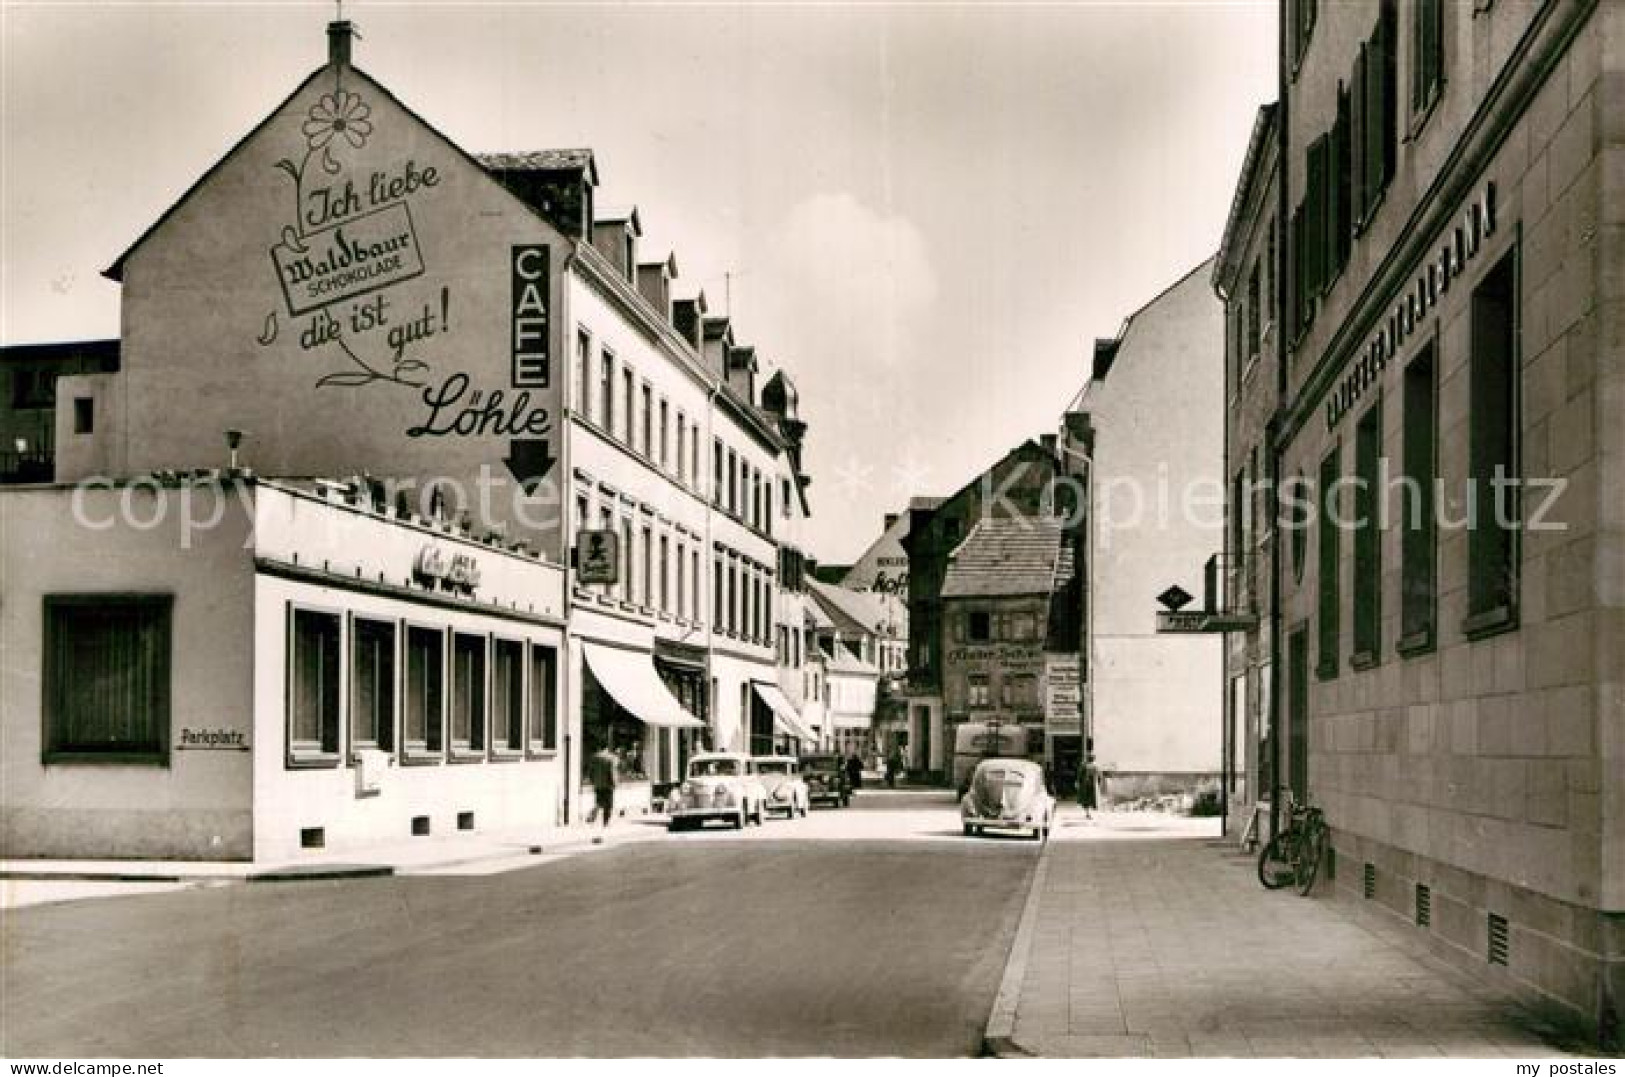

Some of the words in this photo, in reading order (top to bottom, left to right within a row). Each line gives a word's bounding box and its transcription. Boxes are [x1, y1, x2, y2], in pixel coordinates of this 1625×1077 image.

[307, 183, 362, 225] Ich
[367, 161, 440, 205] liebe
[285, 228, 410, 284] Waldbaur
[306, 255, 402, 299] SCHOKOLADE
[300, 312, 341, 350] die
[351, 295, 389, 334] ist
[387, 286, 449, 363] gut!
[515, 250, 547, 386] CAFE
[407, 373, 552, 438] Löhle
[181, 728, 244, 748] Parkplatz
